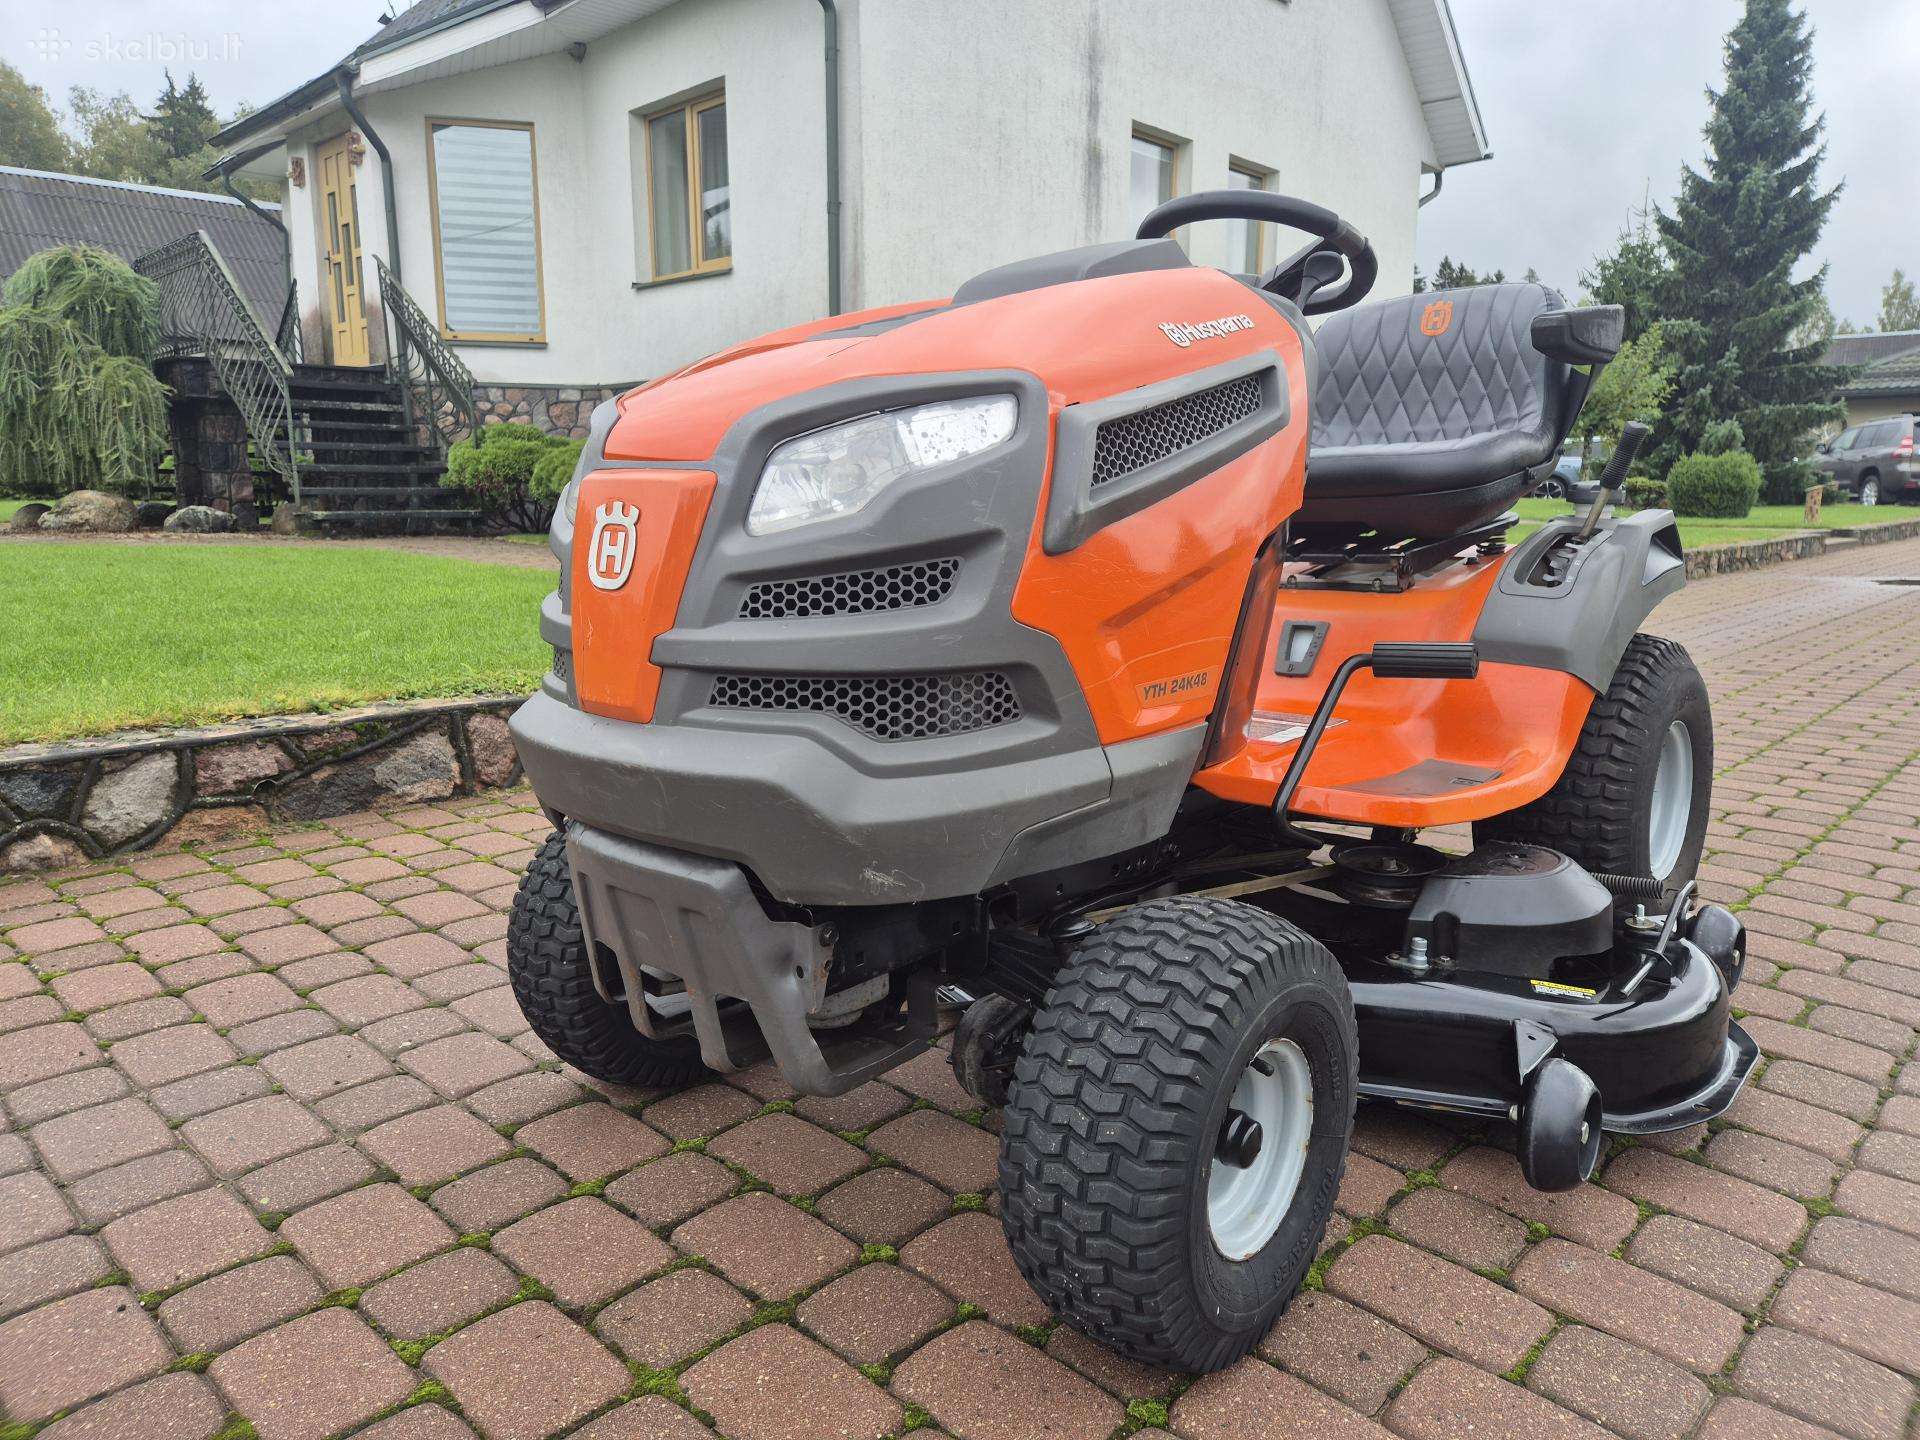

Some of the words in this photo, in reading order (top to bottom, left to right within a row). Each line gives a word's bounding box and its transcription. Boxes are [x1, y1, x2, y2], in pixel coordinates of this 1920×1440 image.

[1180, 313, 1255, 341] Husqvarna
[599, 530, 627, 574] H
[1143, 684, 1167, 700] YTH
[1170, 671, 1208, 693] 24K48
